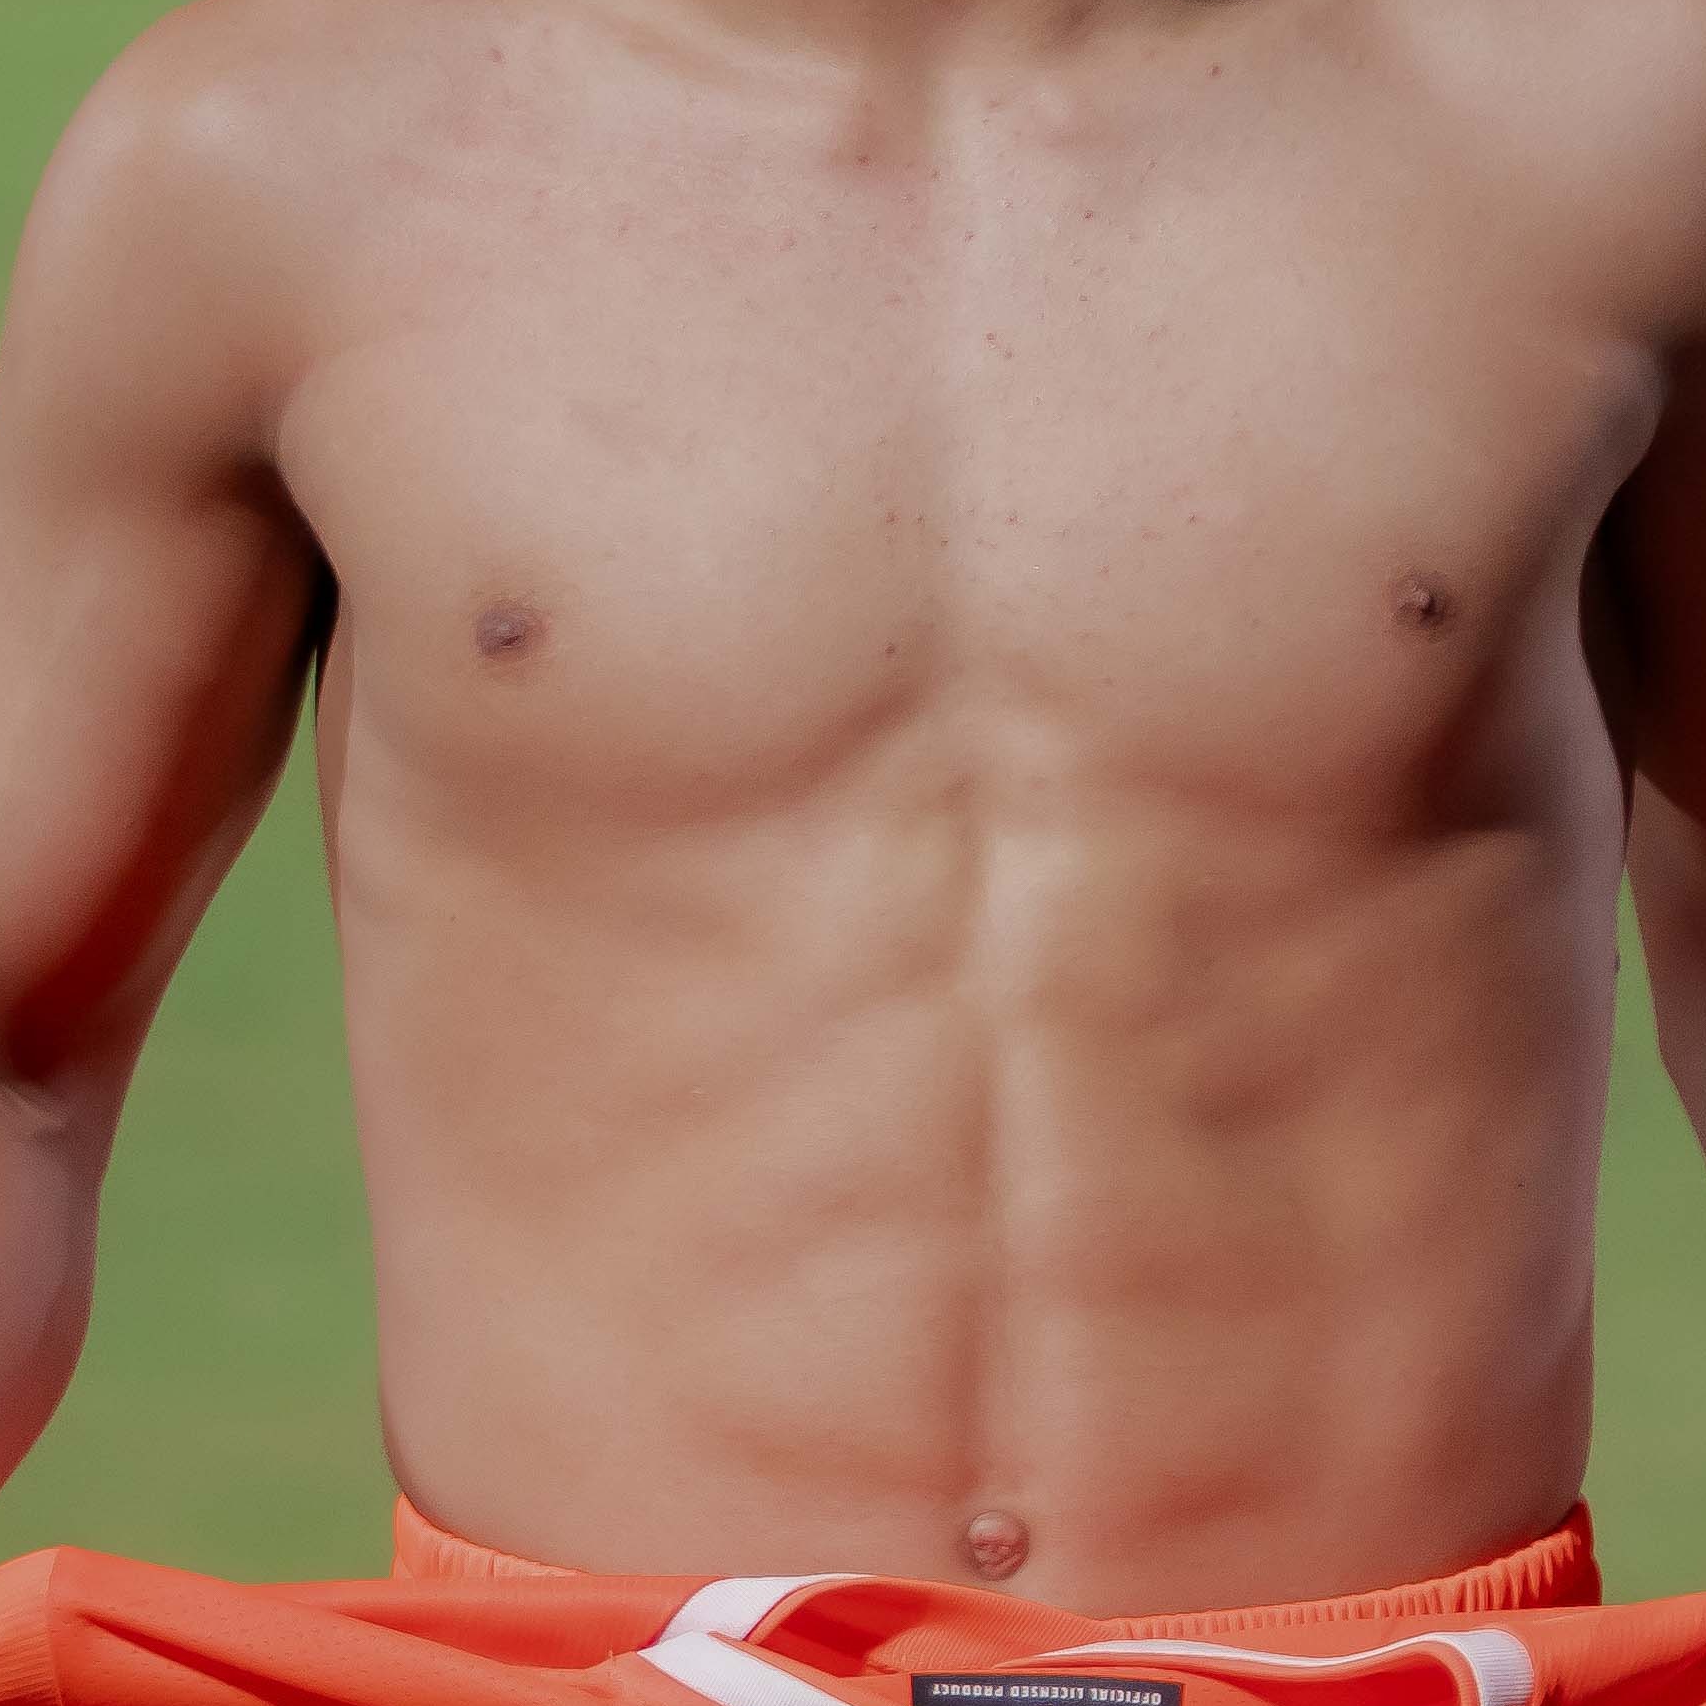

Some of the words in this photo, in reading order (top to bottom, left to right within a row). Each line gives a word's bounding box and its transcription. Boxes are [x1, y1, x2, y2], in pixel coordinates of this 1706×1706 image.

[933, 1683, 1003, 1697] PRODUCT
[1010, 1685, 1084, 1700] LICENSED
[1089, 1687, 1161, 1705] OFFICIAL
